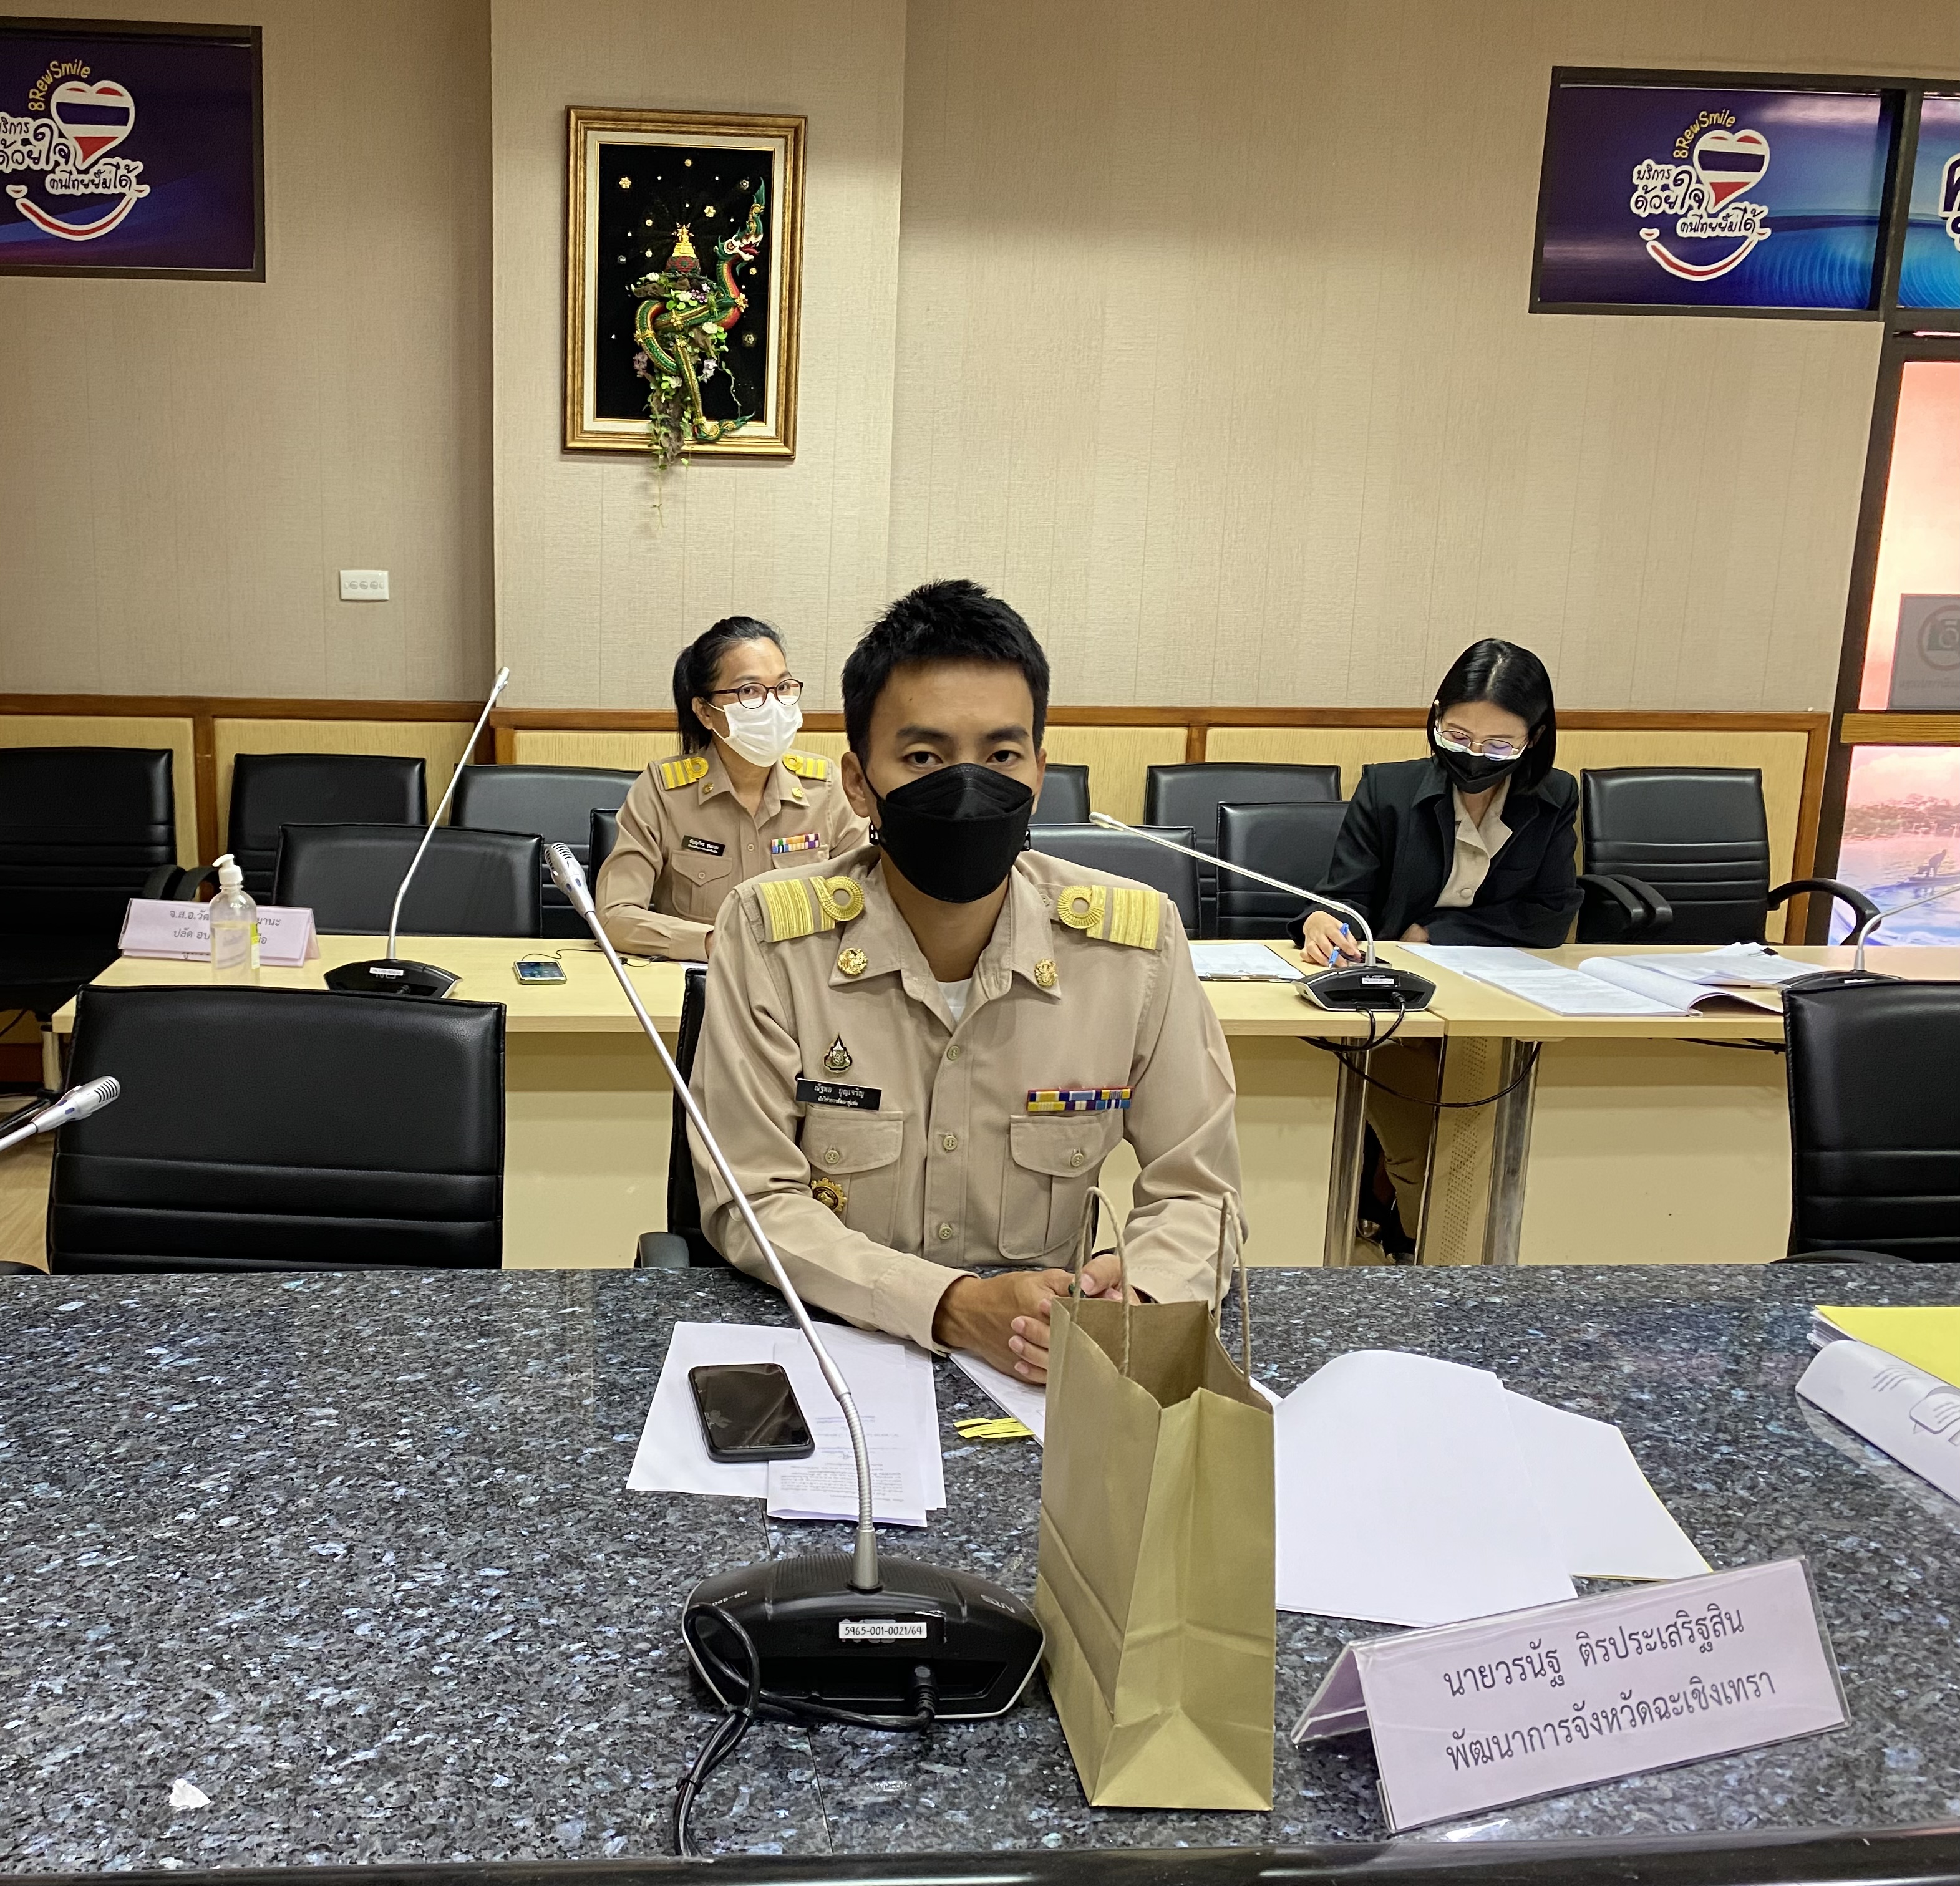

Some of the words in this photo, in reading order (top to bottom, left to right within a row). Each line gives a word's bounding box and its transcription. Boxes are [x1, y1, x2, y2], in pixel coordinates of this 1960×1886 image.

[0, 117, 30, 135] ริการ
[1636, 164, 1672, 181] บริการ
[173, 927, 193, 938] ปลัด
[844, 1626, 922, 1635] 5965-001-0021/64
[1443, 1638, 1565, 1696] นายวรนัฐ
[1576, 1603, 1744, 1666] ติรประเสริฐสิน
[1446, 1671, 1775, 1771] พัฒนาการจังหวัดฉะเชิงเทรา
